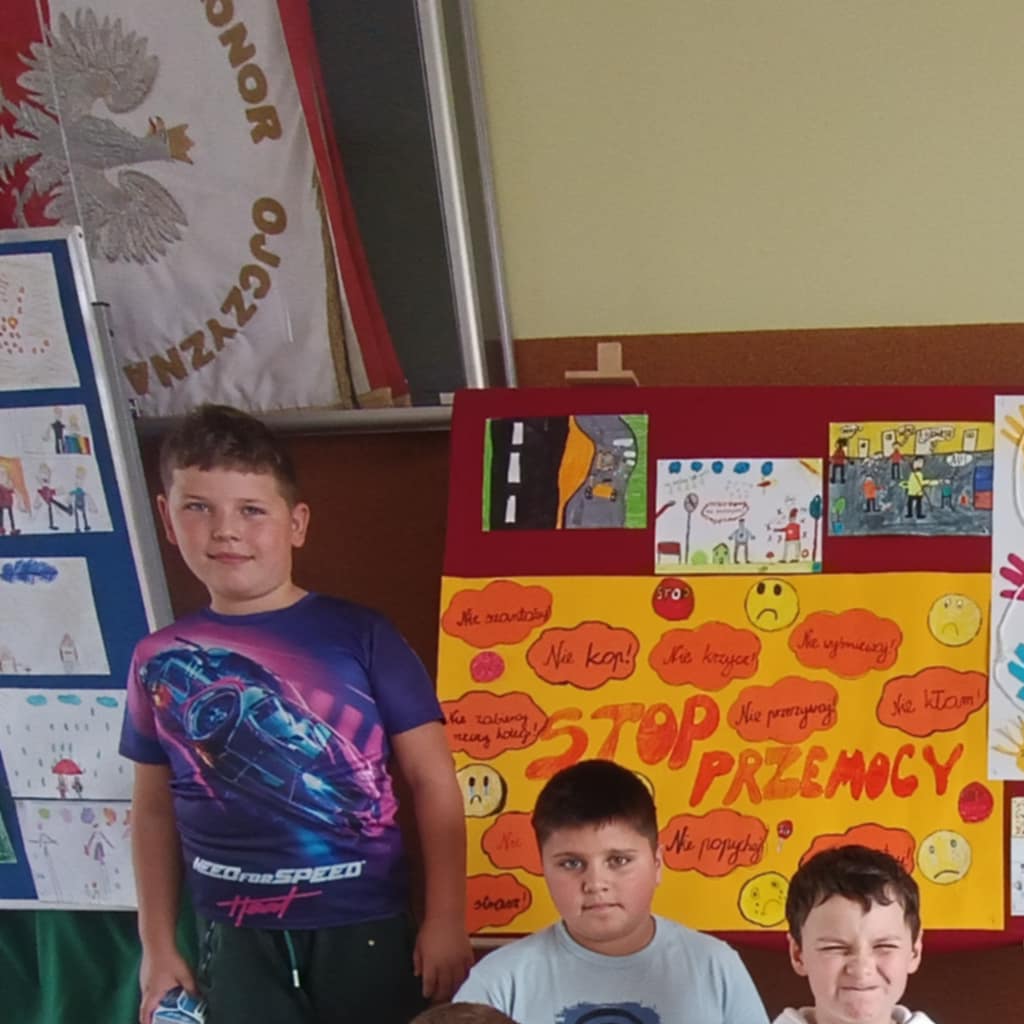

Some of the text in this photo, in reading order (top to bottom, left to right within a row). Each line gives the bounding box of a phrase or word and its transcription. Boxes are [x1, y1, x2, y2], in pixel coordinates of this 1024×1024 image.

[203, 0, 283, 145] ONOR
[123, 197, 287, 396] OJCZYZNA
[543, 640, 632, 672] Nie kop!
[525, 694, 720, 780] STOP
[735, 701, 761, 725] Nie
[689, 743, 964, 807] PRZEMOCY
[665, 826, 695, 855] Nie
[271, 860, 366, 885] SPEED
